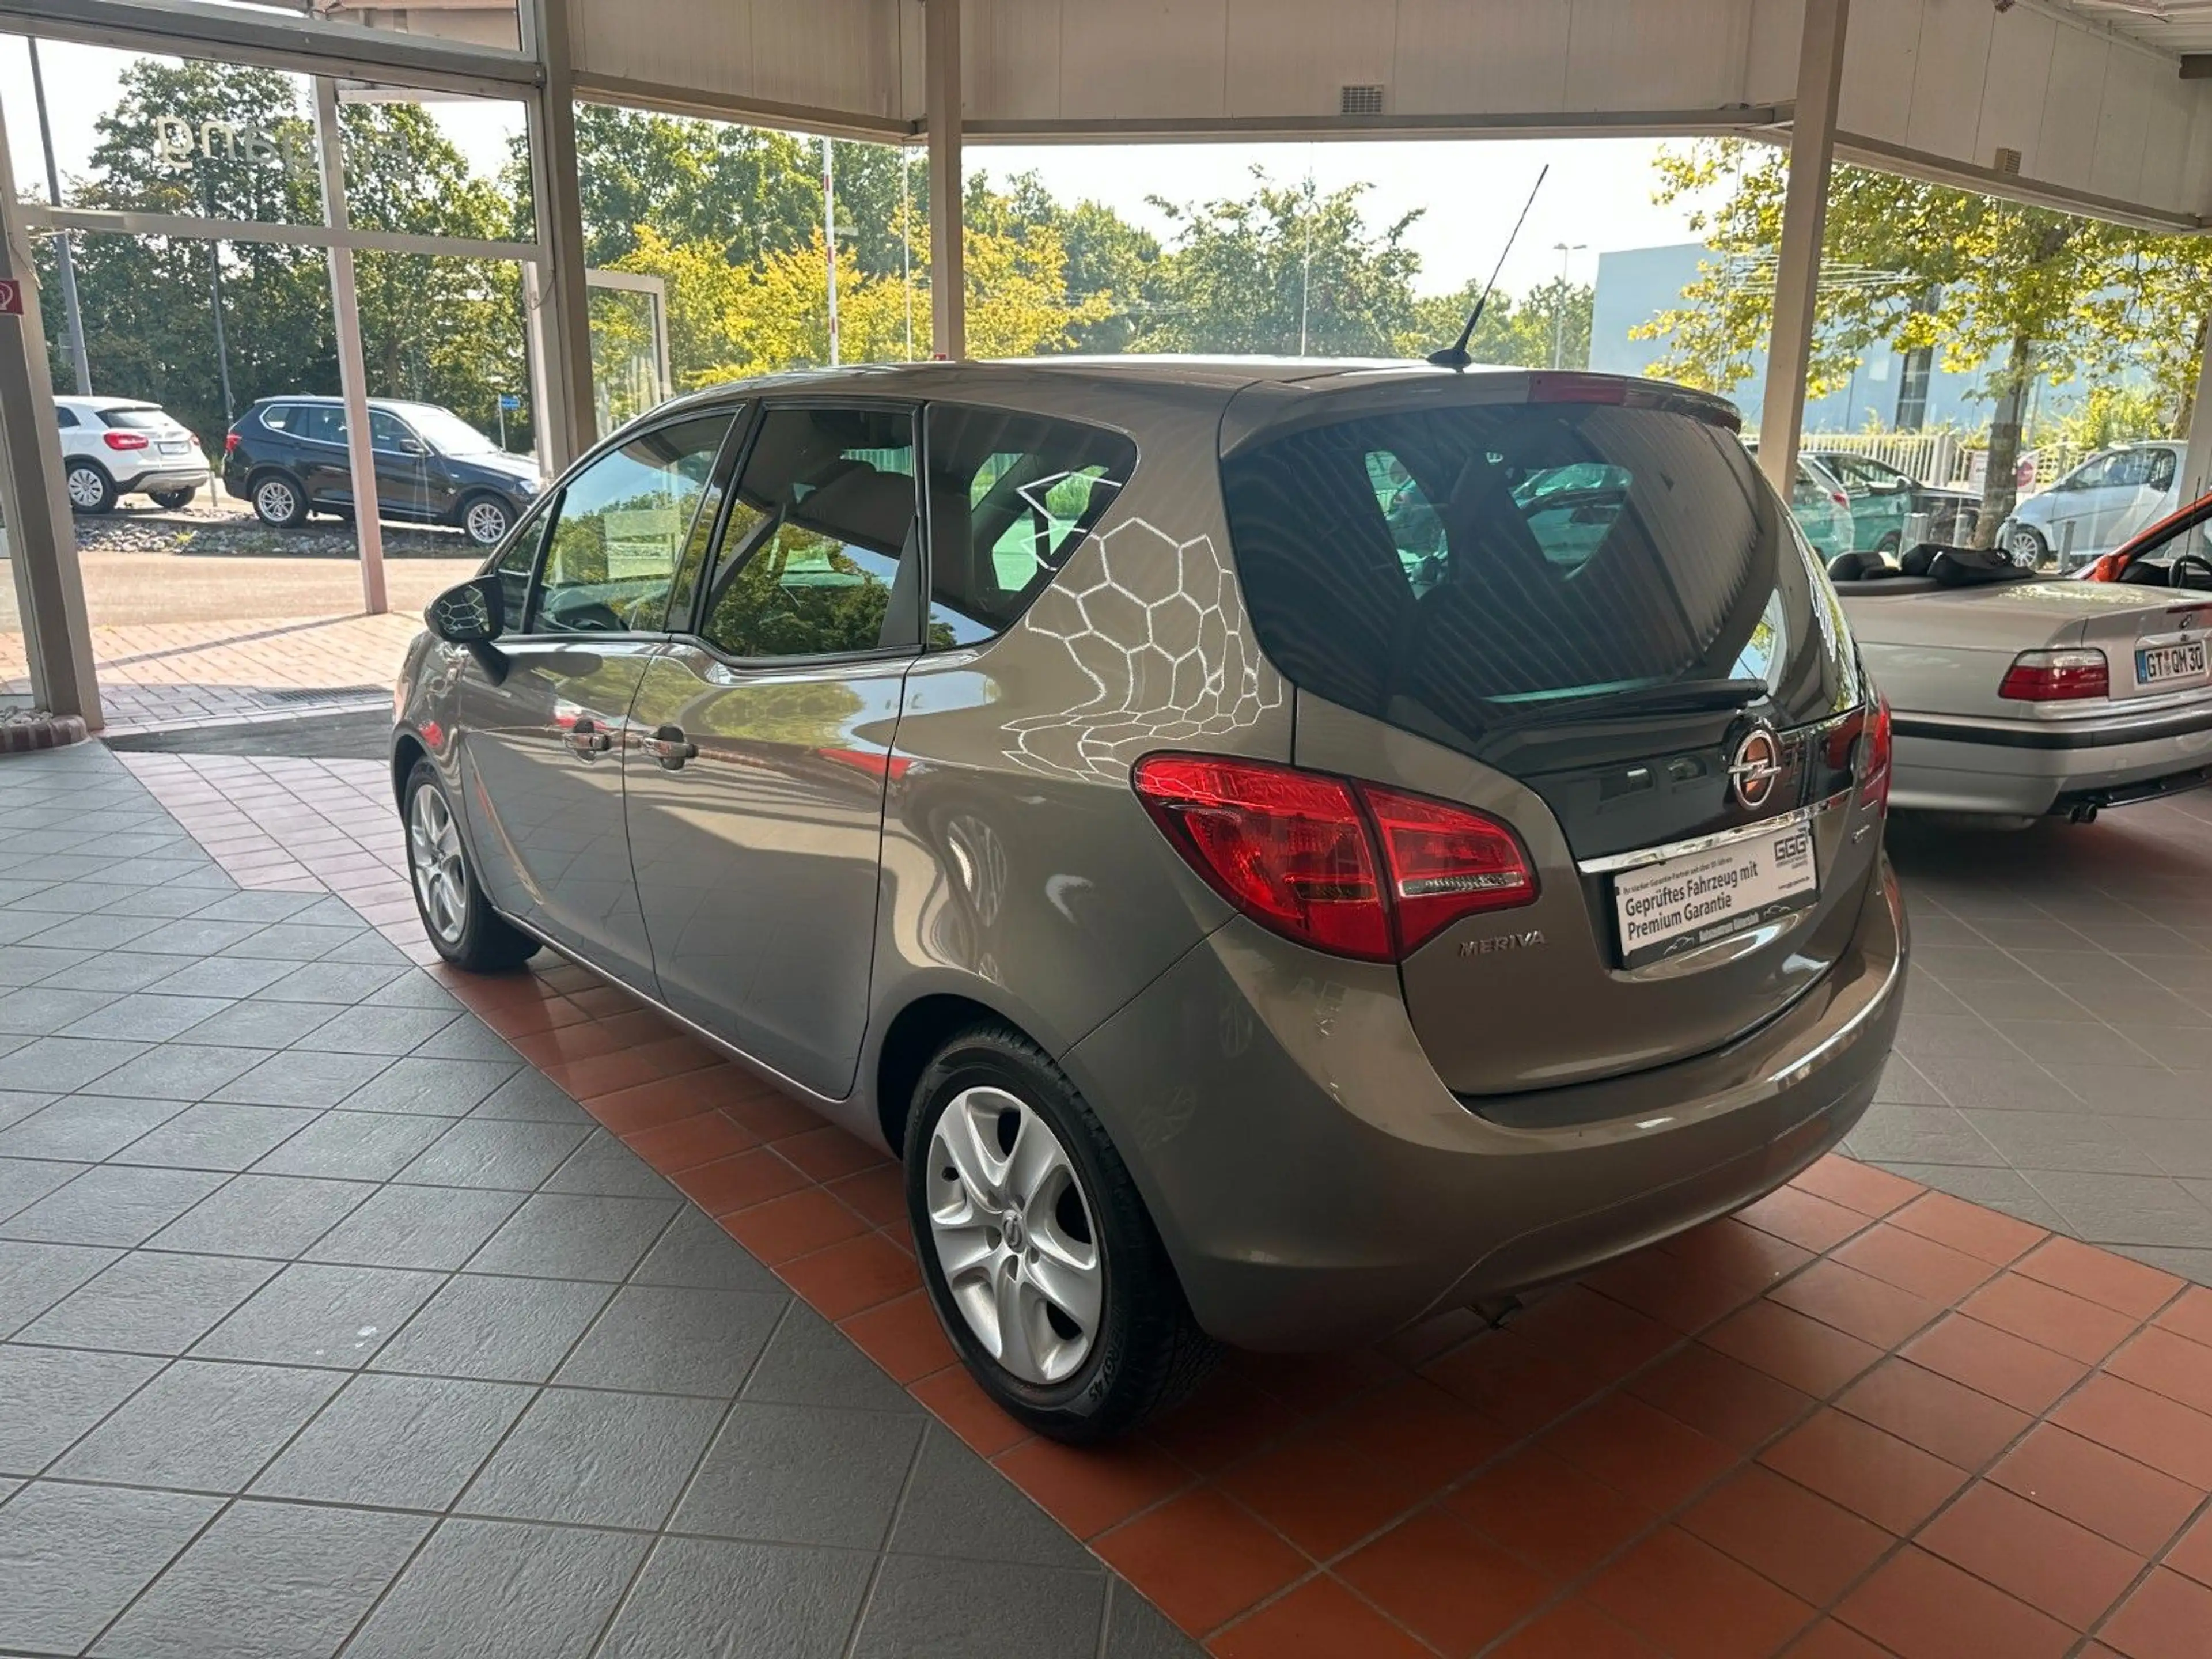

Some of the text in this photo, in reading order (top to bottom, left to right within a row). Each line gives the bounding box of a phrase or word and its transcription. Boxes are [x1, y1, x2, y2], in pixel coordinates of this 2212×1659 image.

[2147, 652, 2162, 677] GT
[2188, 646, 2203, 671] 30
[1774, 833, 1807, 861] GGG
[1626, 862, 1758, 916] Geprüftes Fahrzeug mit
[1628, 911, 1681, 940] Premium
[1684, 892, 1732, 921] Garantie
[1459, 930, 1545, 957] MERIVA
